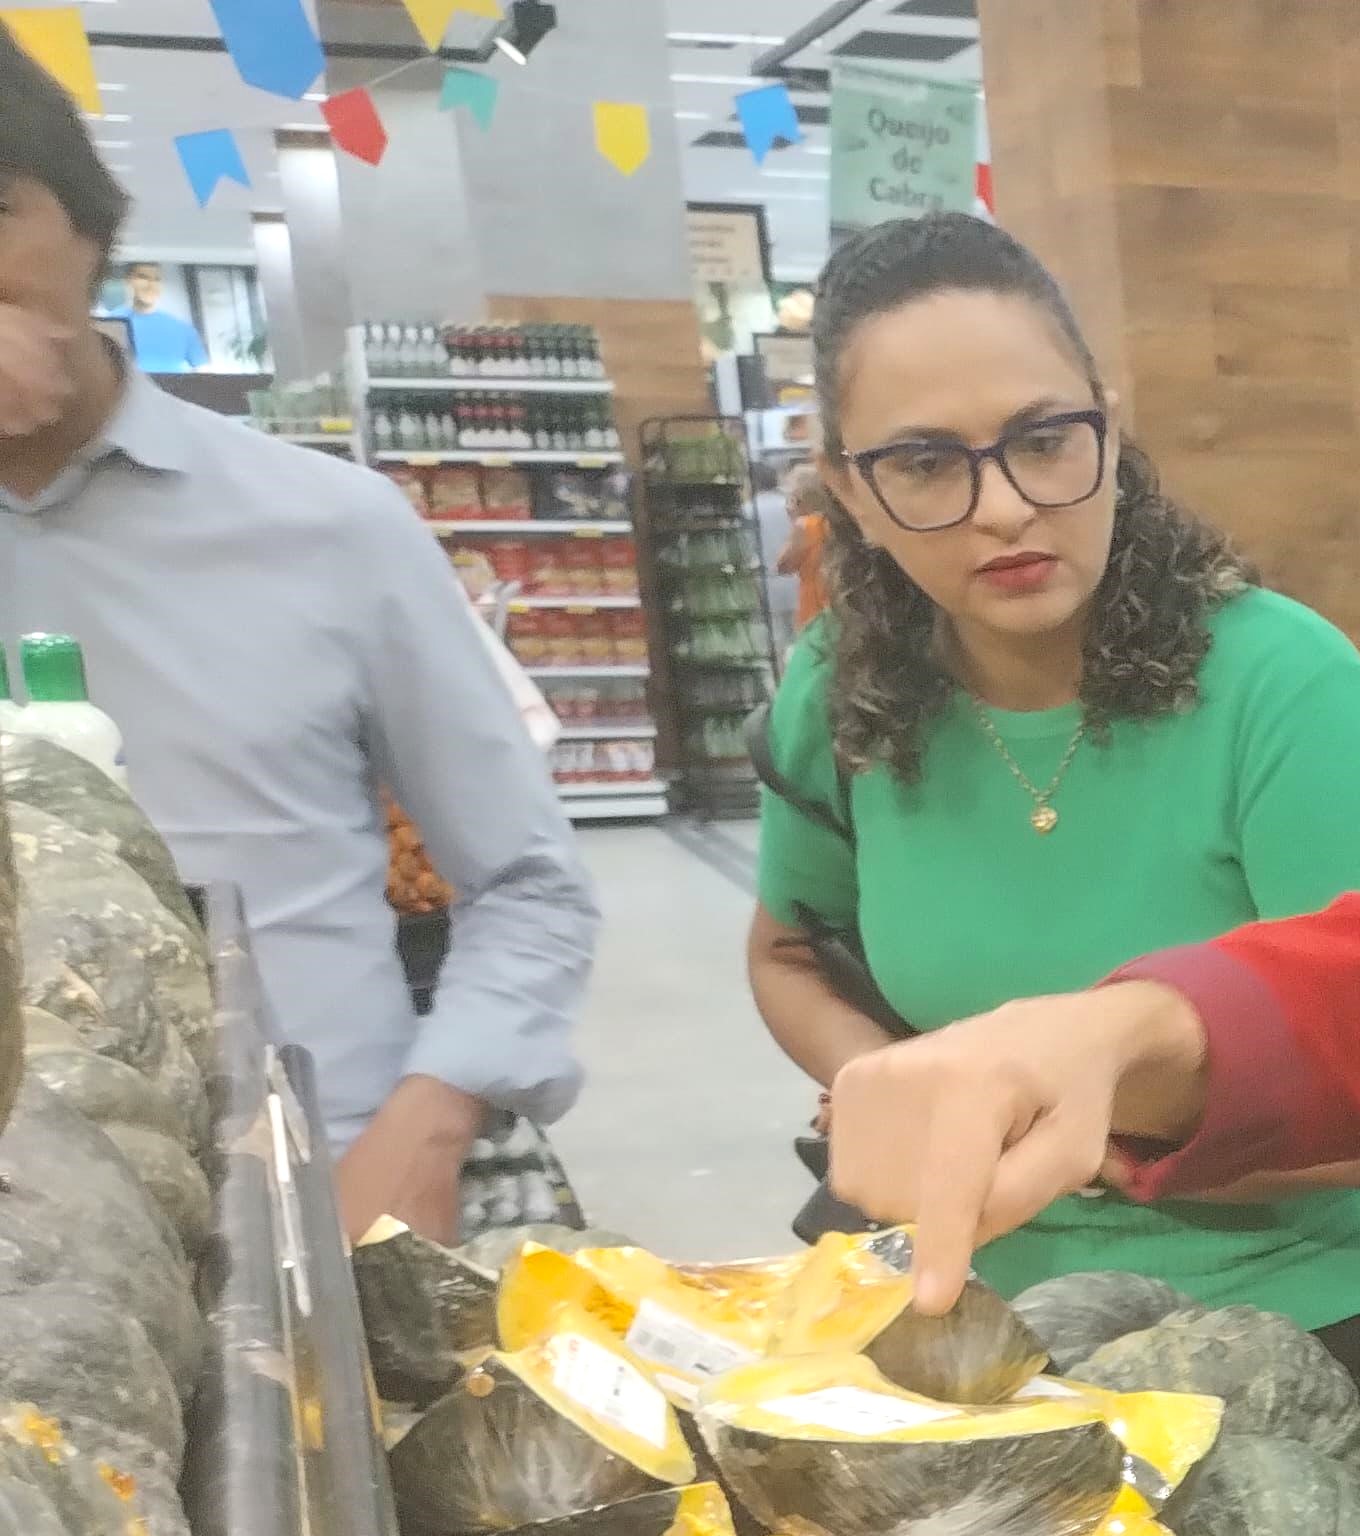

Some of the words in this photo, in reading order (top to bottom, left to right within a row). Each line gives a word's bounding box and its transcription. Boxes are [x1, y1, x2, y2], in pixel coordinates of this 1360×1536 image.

[867, 107, 950, 149] Queijo
[892, 146, 923, 174] de
[869, 176, 944, 209] Cabra
